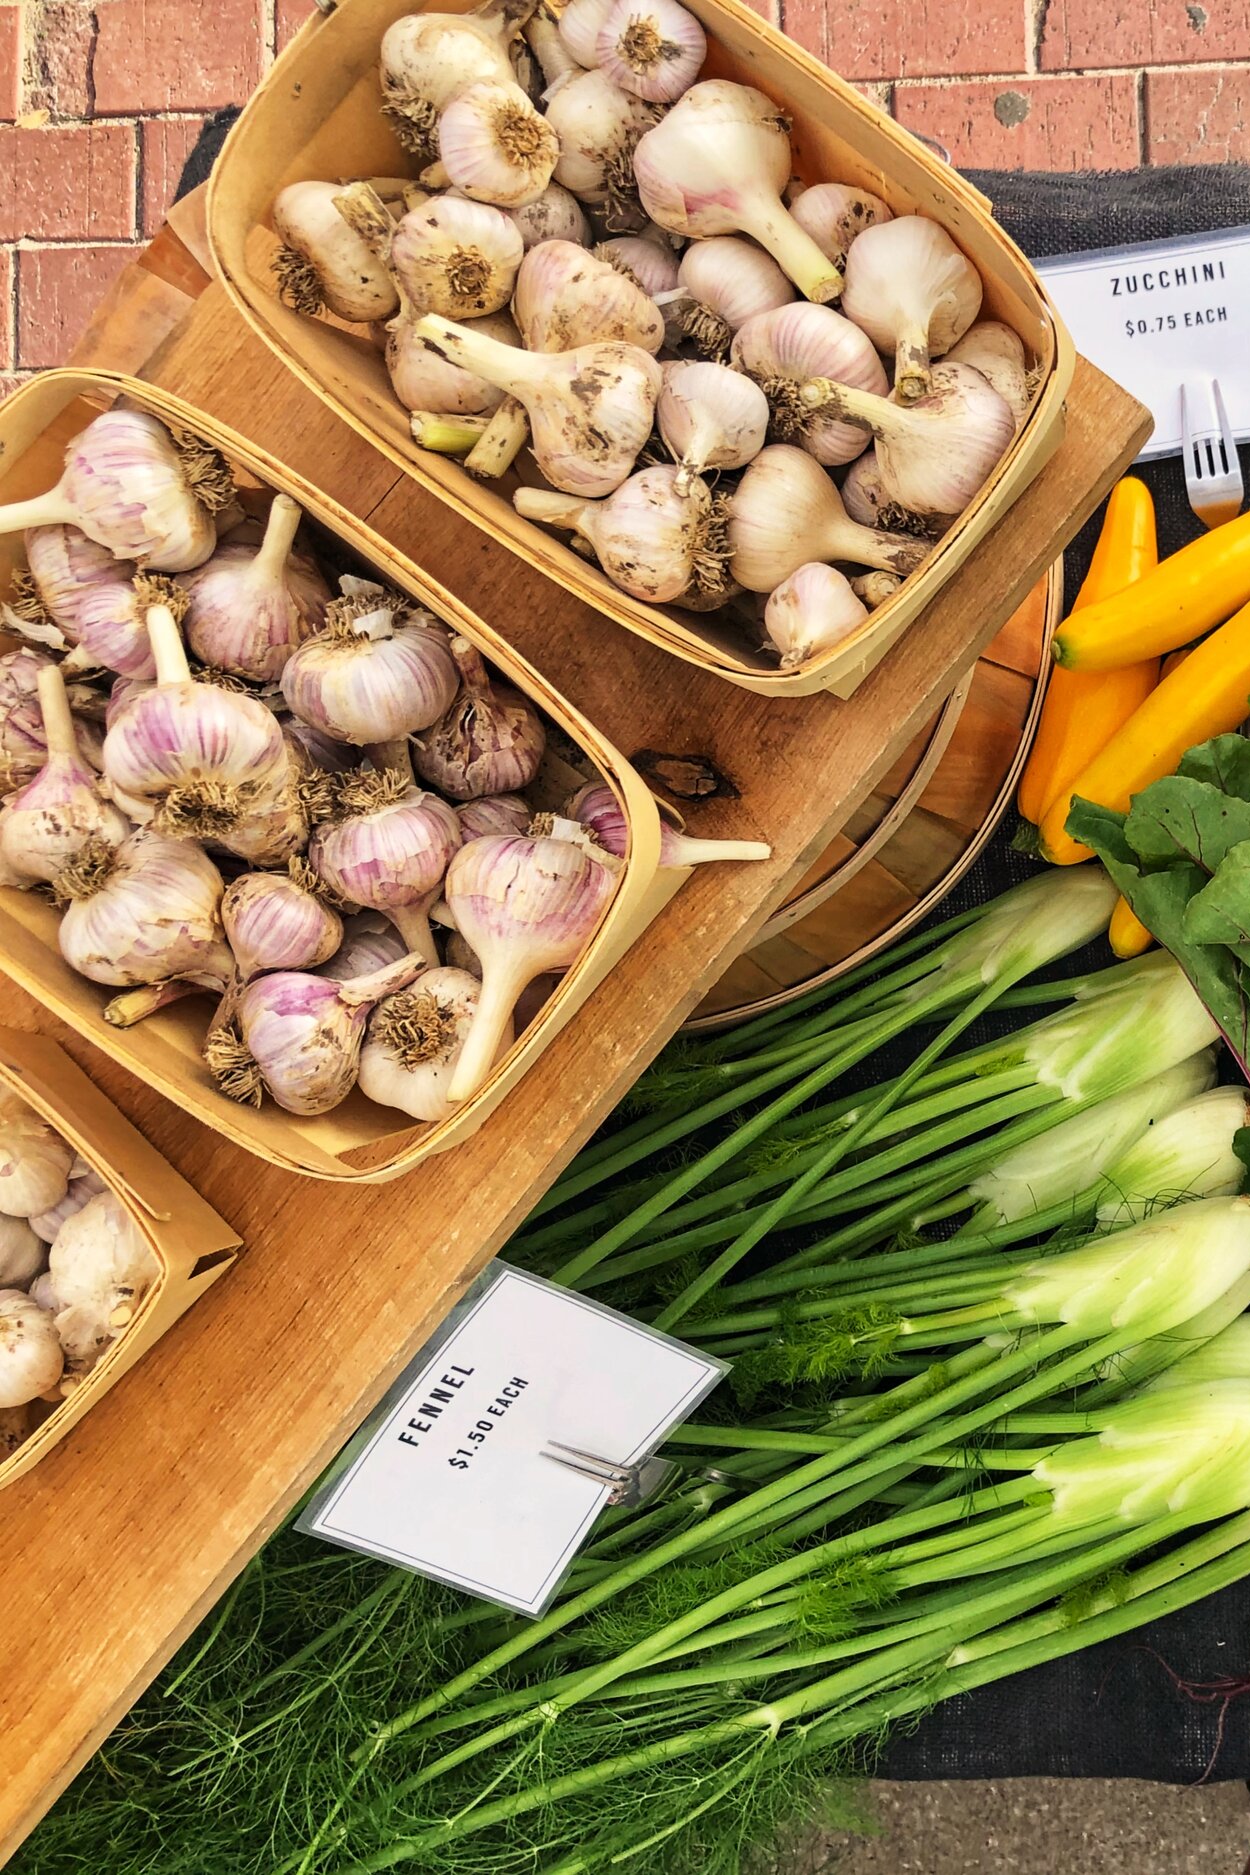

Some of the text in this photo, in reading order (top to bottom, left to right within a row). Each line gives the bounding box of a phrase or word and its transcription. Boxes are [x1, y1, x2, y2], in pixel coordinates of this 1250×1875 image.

[1110, 261, 1225, 296] ZUCCHINI
[1125, 306, 1228, 338] $0.75 EACH
[397, 1365, 475, 1447] FENNEL
[448, 1377, 529, 1469] $1.50 EACH
